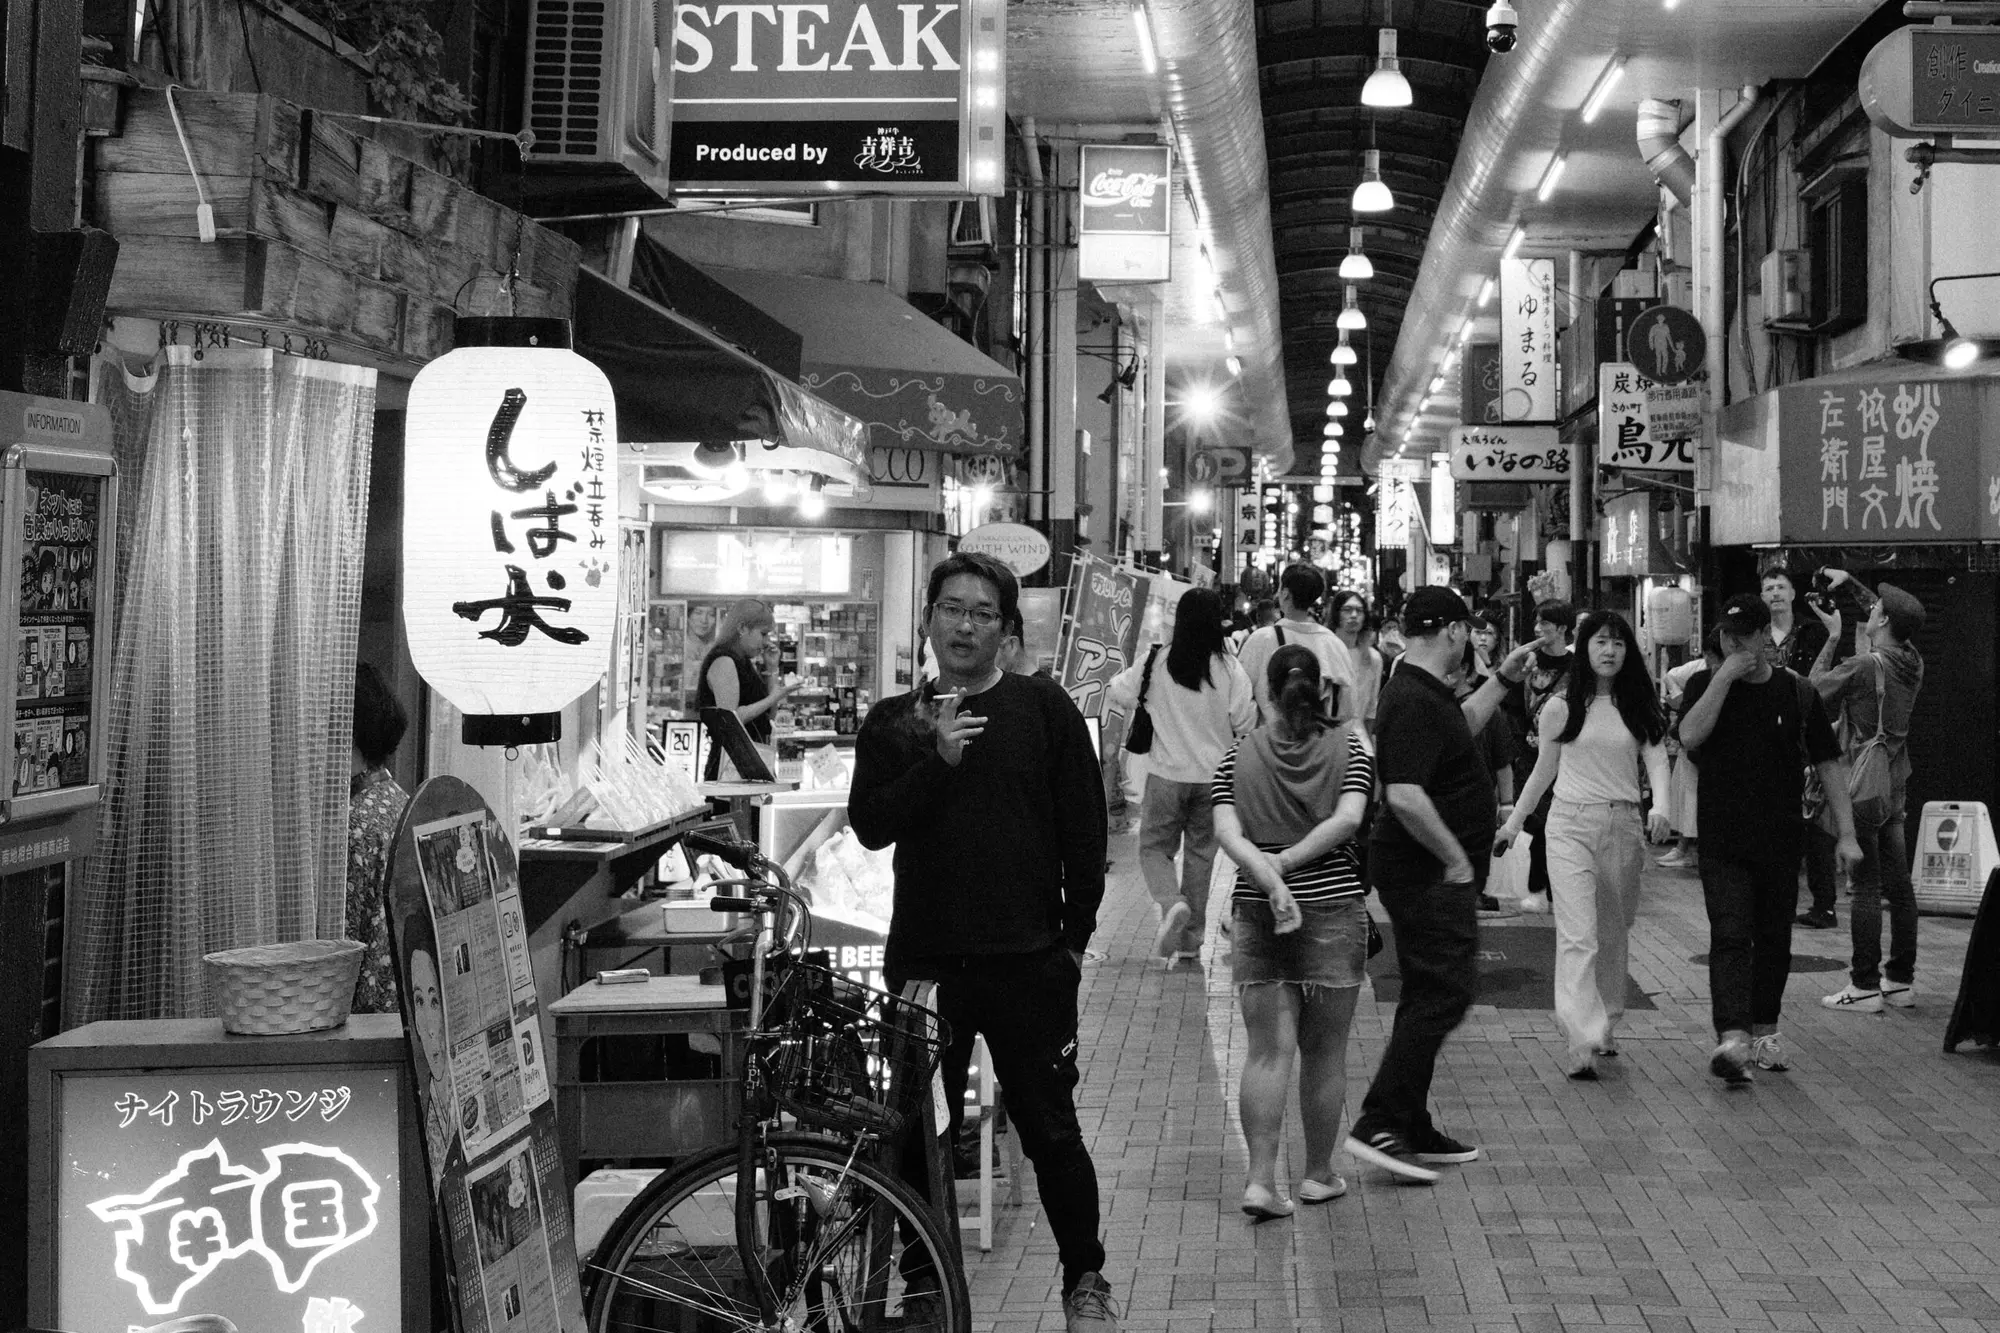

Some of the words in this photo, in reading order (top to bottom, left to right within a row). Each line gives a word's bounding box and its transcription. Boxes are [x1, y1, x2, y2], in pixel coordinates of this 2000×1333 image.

[674, 4, 960, 73] STEAK
[1927, 45, 1967, 79] 創作
[696, 144, 796, 162] Produced
[803, 144, 828, 165] by
[861, 136, 914, 156] 吉祥吉
[1090, 172, 1158, 197] Coca-Cola
[1519, 294, 1538, 387] ゆまる
[1611, 402, 1642, 414] さか町
[27, 413, 81, 434] INFORMATION
[1461, 433, 1508, 445] 大阪うどん
[1819, 390, 1849, 531] 左衛門
[452, 387, 590, 647] しば犬
[960, 543, 1002, 554] SOUTH
[1008, 543, 1047, 554] WIND
[115, 1086, 351, 1128] ナイトラウンジ
